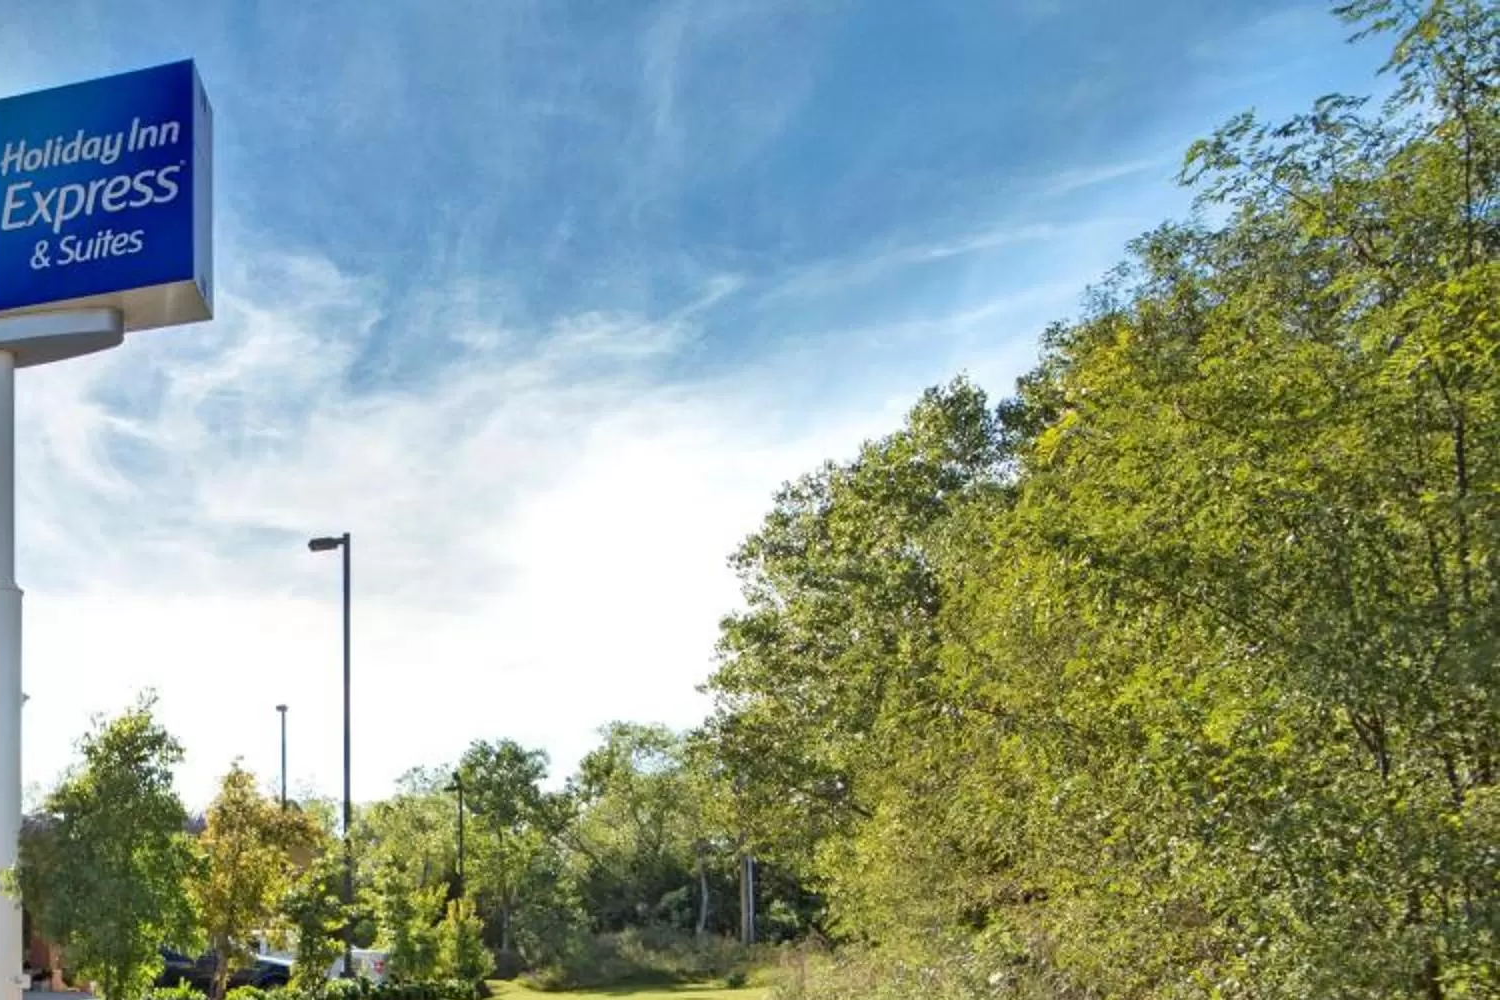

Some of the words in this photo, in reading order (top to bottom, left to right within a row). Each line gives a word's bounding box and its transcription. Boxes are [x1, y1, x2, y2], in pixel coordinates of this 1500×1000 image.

[1, 129, 123, 176] Holiday
[127, 117, 180, 152] Inn
[1, 165, 181, 234] Express
[30, 240, 50, 270] &
[57, 229, 144, 265] Suites
